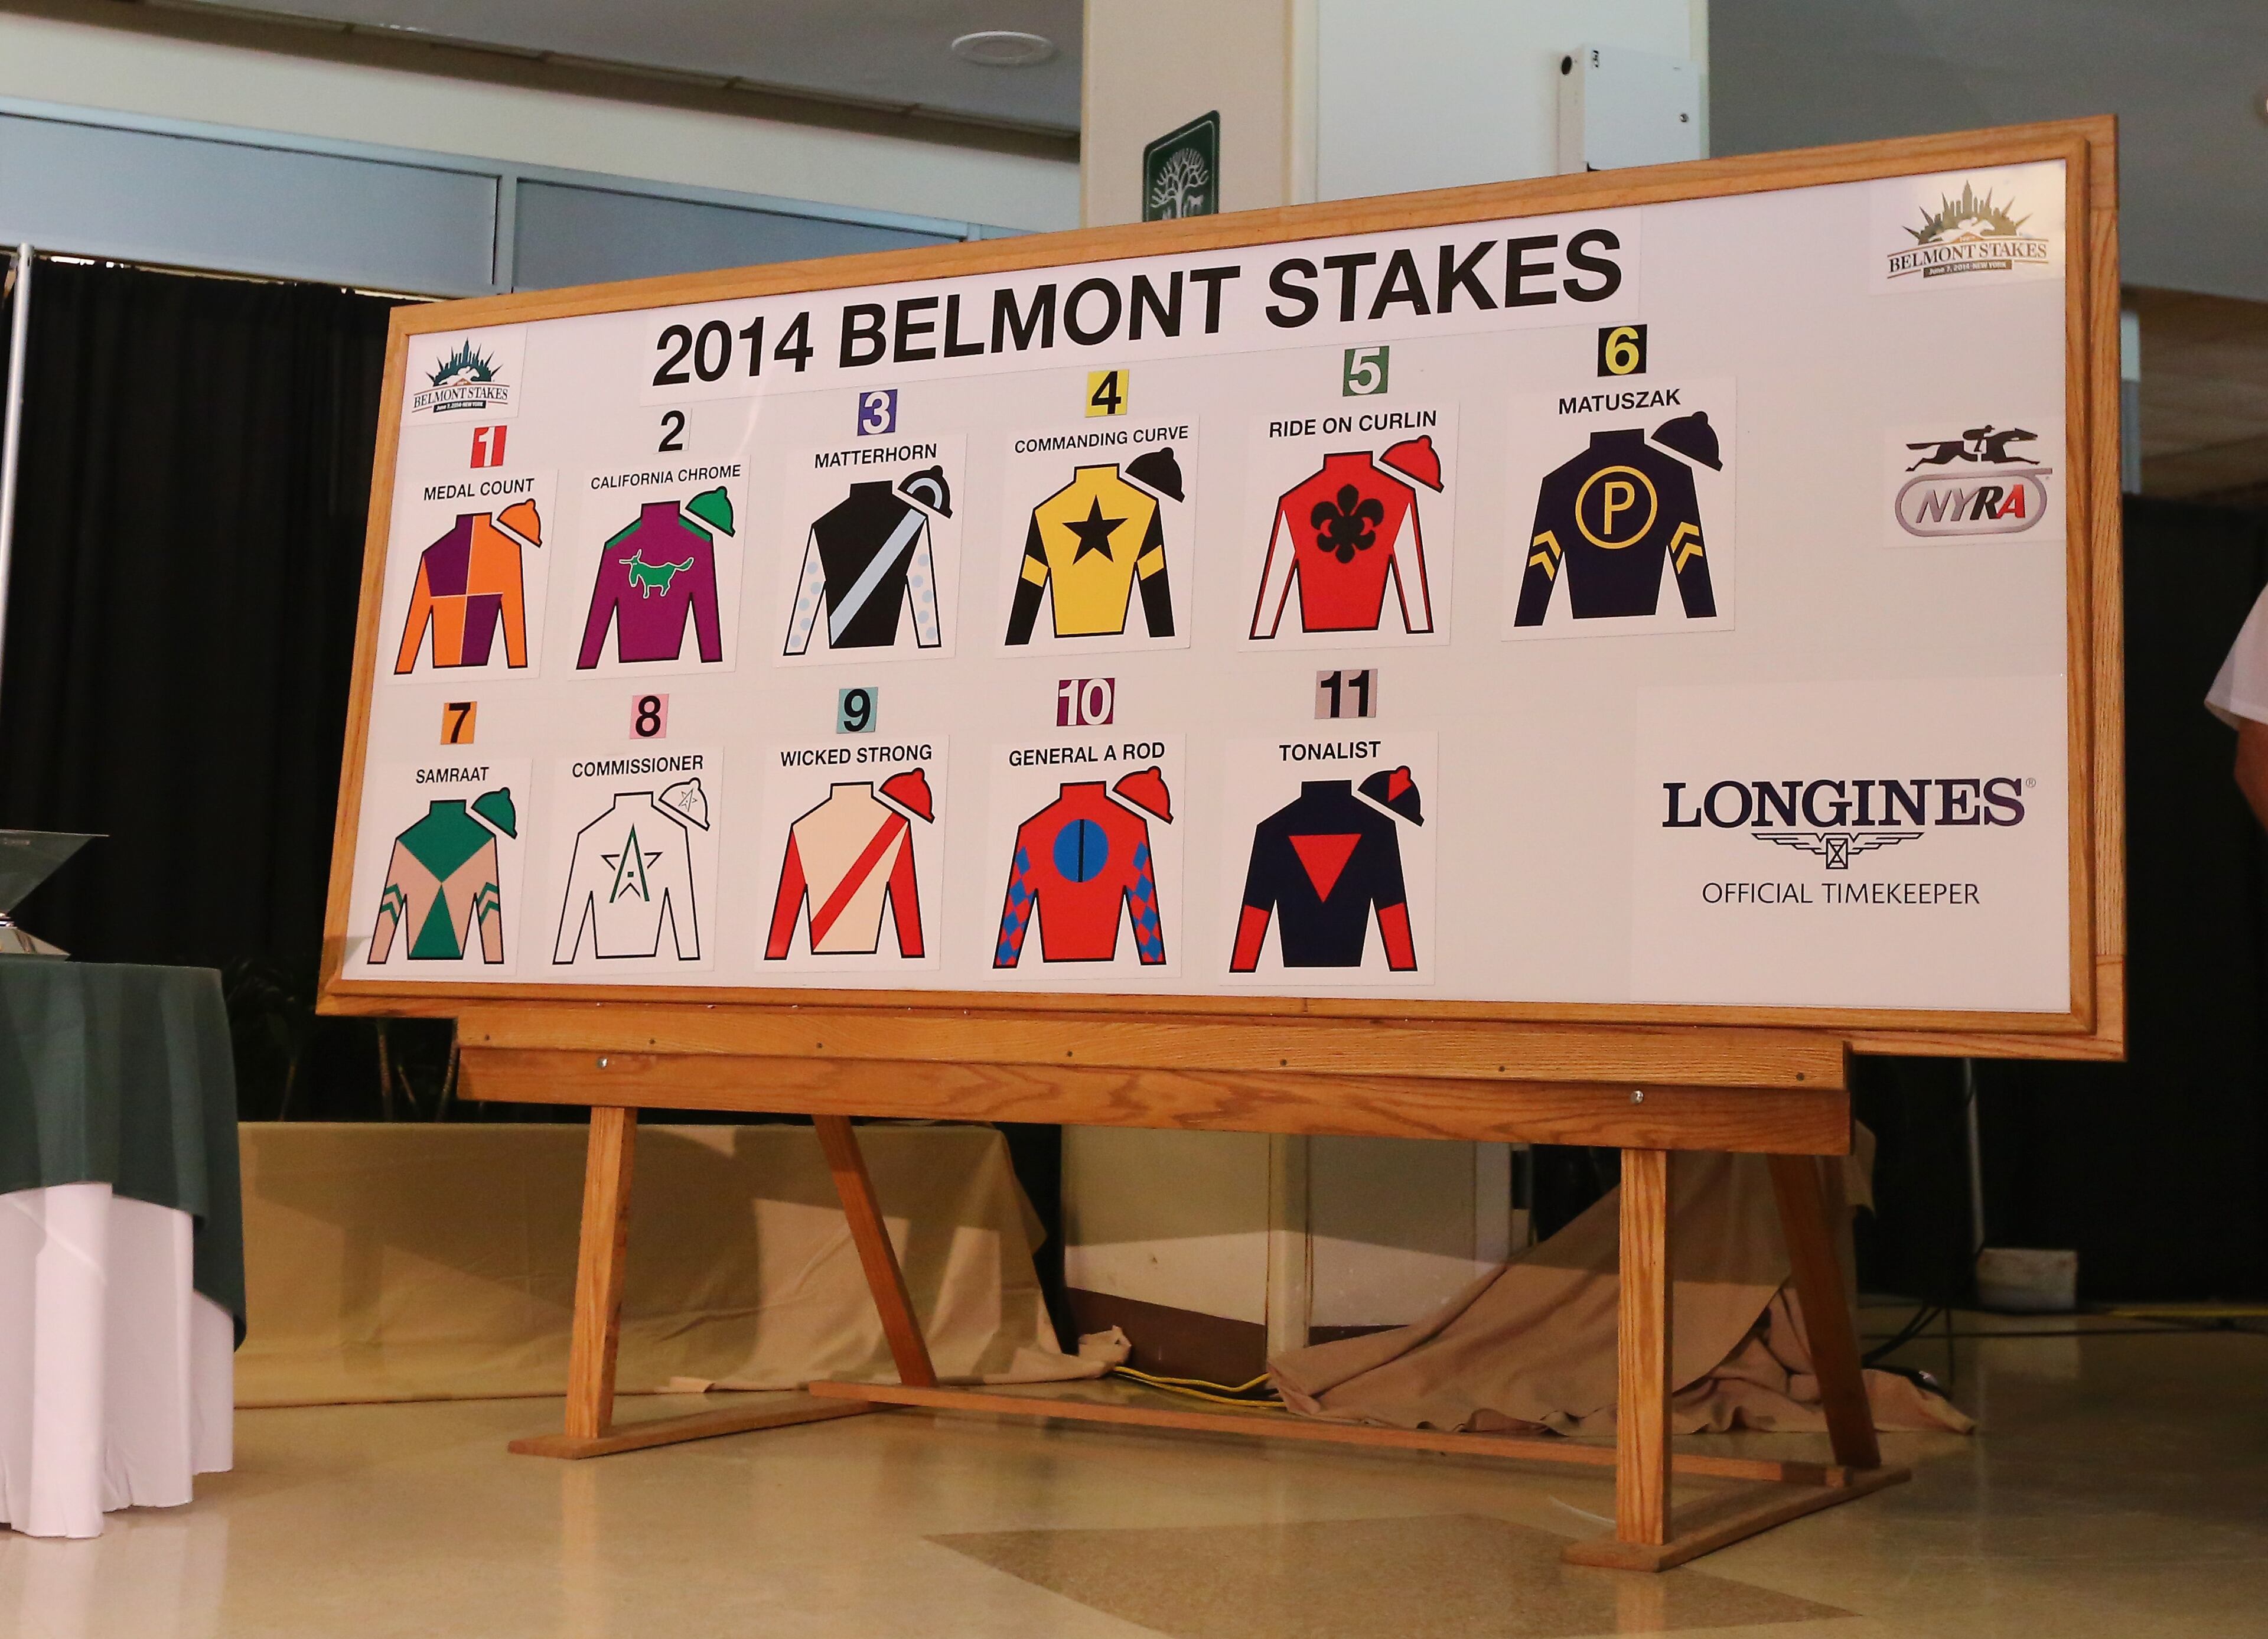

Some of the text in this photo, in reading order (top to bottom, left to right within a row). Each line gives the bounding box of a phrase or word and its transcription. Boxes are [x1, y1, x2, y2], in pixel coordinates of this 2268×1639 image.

[1890, 242, 2047, 273] BELMONT STAKES
[653, 229, 1622, 386] 2014 BELMONT STAKES
[1348, 347, 1383, 395] 5
[1605, 327, 1640, 375] 6
[414, 387, 508, 408] BELMONT STAKES
[863, 391, 891, 435] 3
[1091, 371, 1122, 415] 4
[1558, 388, 1681, 415] MATUSZAK
[659, 410, 685, 452] 2
[1015, 426, 1188, 453] COMMANDING CURVE
[1270, 410, 1436, 438] RIDE ON CURLIN
[478, 426, 494, 467] 1
[815, 444, 937, 468] MATTERHORN
[423, 478, 535, 501] MEDAL COUNT
[591, 465, 741, 489] CALIFORNIA CHROME
[1604, 481, 1635, 535] P
[1916, 484, 2026, 524] NYRA
[843, 689, 871, 732] 9
[1059, 678, 1113, 725] 10
[1321, 670, 1370, 717] 11
[448, 702, 471, 744] 7
[634, 695, 662, 738] 8
[572, 755, 703, 778] COMMISSIONER
[781, 744, 932, 766] WICKED STRONG
[1009, 742, 1164, 766] GENERAL A ROD
[1279, 741, 1381, 761] TONALIST
[416, 767, 489, 783] SAMRAAT
[1663, 778, 2025, 828] LONGINES
[1703, 883, 1979, 904] OFFICIAL TIMEKEEPER
